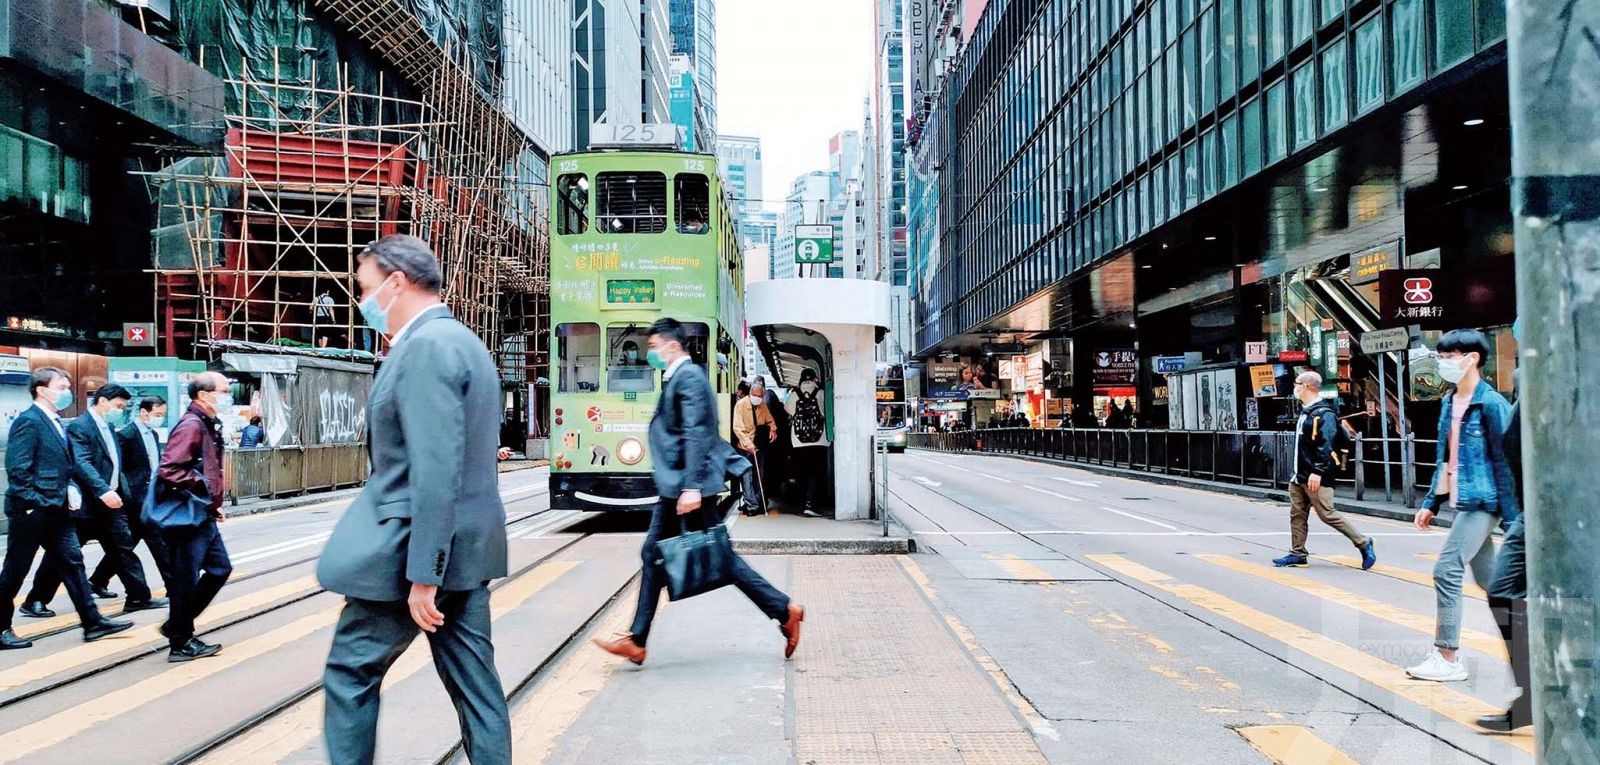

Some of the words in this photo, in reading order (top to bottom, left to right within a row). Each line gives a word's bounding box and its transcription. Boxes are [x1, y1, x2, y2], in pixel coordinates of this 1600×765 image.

[612, 124, 655, 142] 125
[560, 161, 578, 172] 125
[684, 160, 705, 172] 125
[609, 287, 631, 295] Happy
[633, 286, 655, 295] Valley
[1394, 306, 1444, 318] 大新銀行
[1248, 344, 1265, 355] FT
